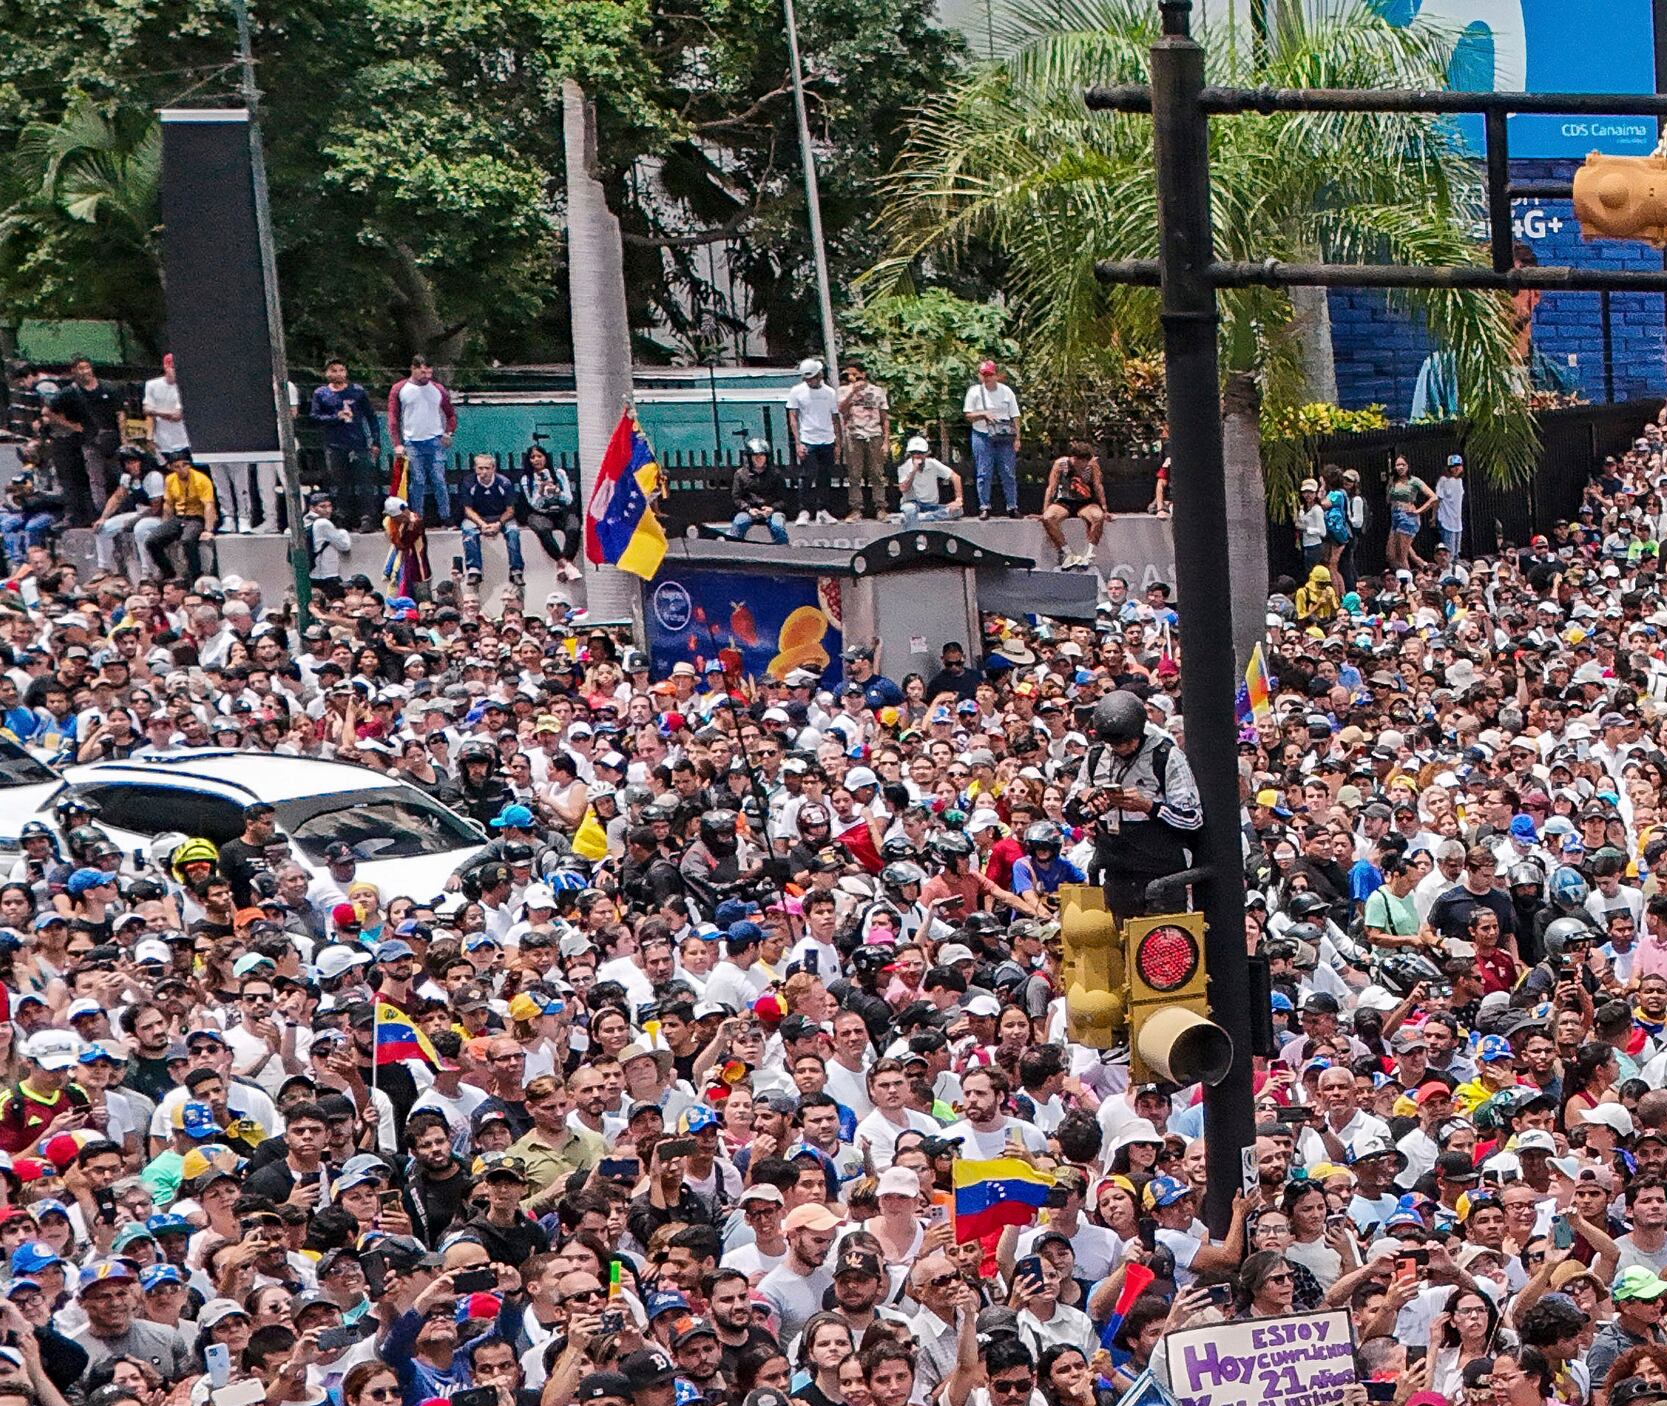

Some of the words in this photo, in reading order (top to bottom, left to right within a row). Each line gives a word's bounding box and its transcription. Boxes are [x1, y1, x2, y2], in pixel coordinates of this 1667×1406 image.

[1561, 123, 1589, 137] CDS
[1591, 123, 1647, 137] Canaima
[1251, 1321, 1330, 1350] ESTOY
[1258, 1365, 1307, 1399] 21
[1309, 1368, 1356, 1391] AÑOS
